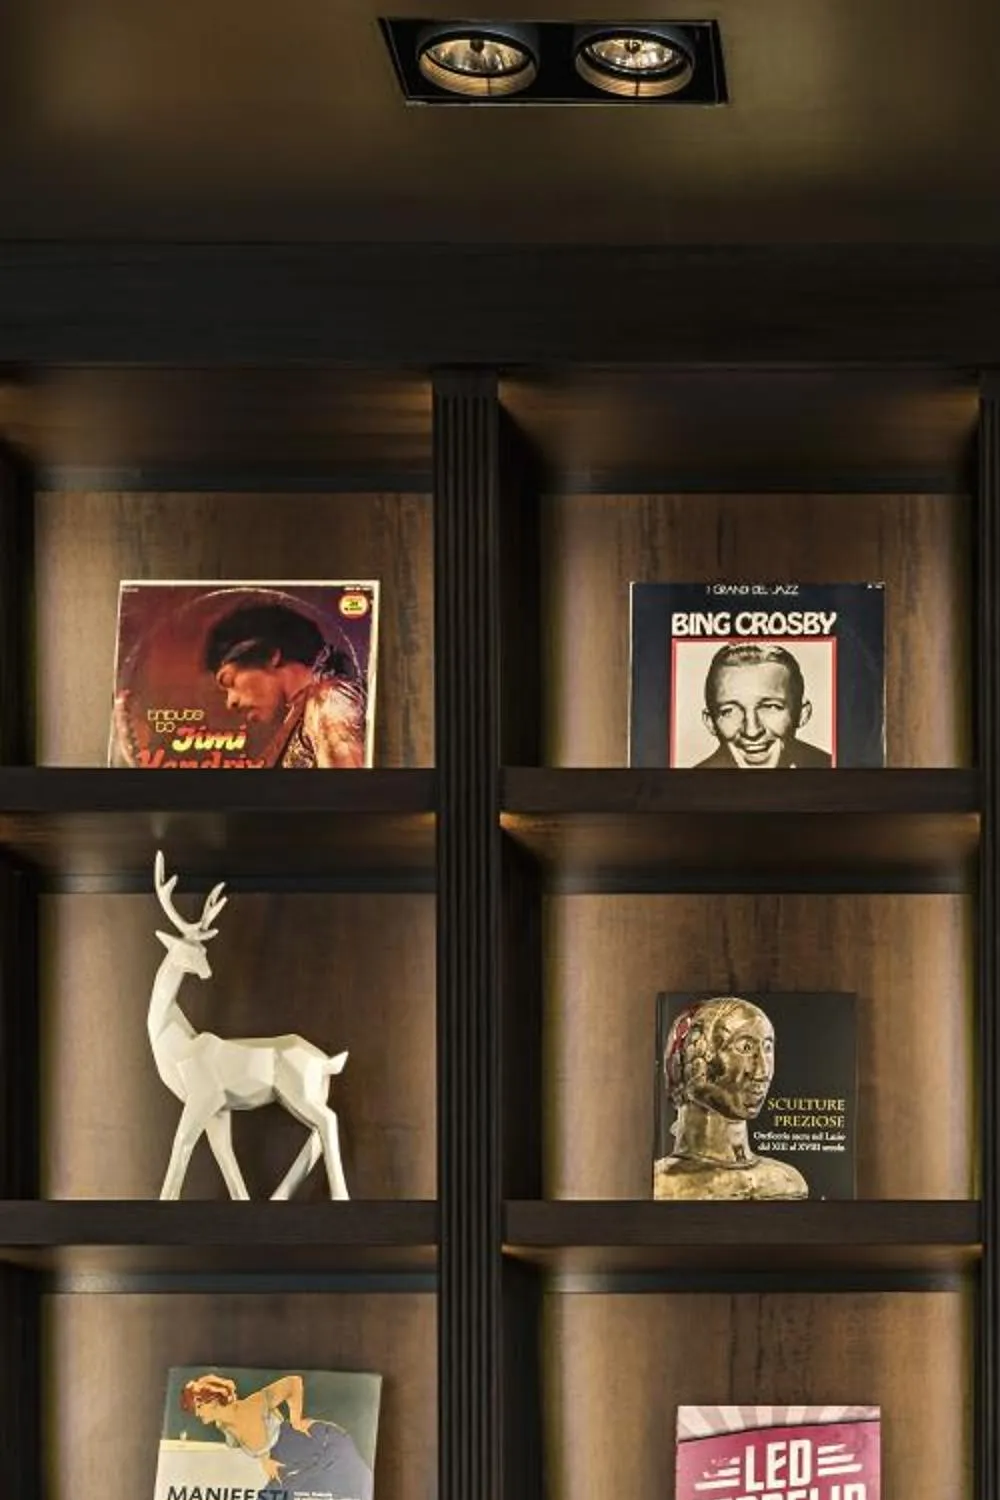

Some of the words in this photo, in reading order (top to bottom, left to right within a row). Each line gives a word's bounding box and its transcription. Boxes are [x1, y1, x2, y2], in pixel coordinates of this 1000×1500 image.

[771, 584, 799, 595] JAZZ
[671, 612, 731, 636] BING
[735, 611, 837, 636] CROSBY
[171, 724, 247, 751] Jimi
[767, 1098, 845, 1111] SCULTURE
[774, 1115, 845, 1128] PREZIOSE
[745, 1439, 812, 1492] LED
